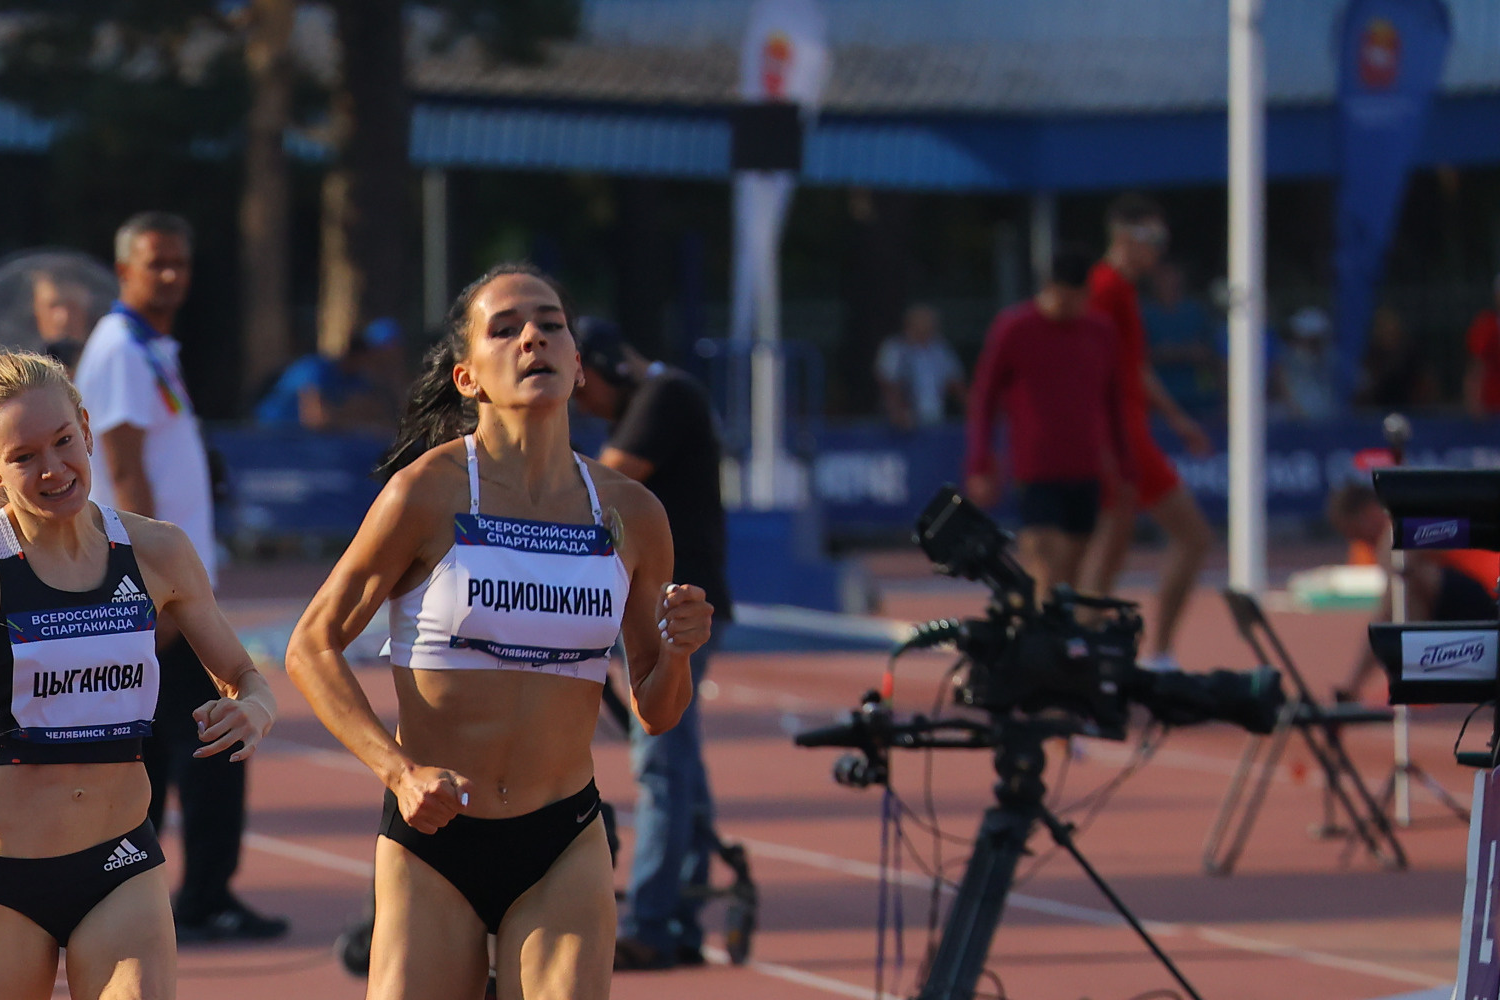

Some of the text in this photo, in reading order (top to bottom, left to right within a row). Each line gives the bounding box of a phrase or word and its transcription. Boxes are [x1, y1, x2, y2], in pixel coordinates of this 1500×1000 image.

[477, 518, 597, 541] ВСЕРОССИЙСКАЯ
[486, 532, 590, 553] СПАРТАКИАДА
[111, 591, 148, 603] adidas
[467, 578, 613, 618] РОДИОШКИНА
[31, 605, 139, 626] ВСЕРОССИЙСКАЯ
[40, 618, 135, 637] СПАРТАКИАДА
[487, 644, 581, 660] ЧЕЛЯБИНСК 2022
[32, 663, 144, 699] ЦЫГАНОВА
[45, 726, 132, 740] ЧЕЛЯБИНСК 2022
[103, 850, 149, 872] adidas
